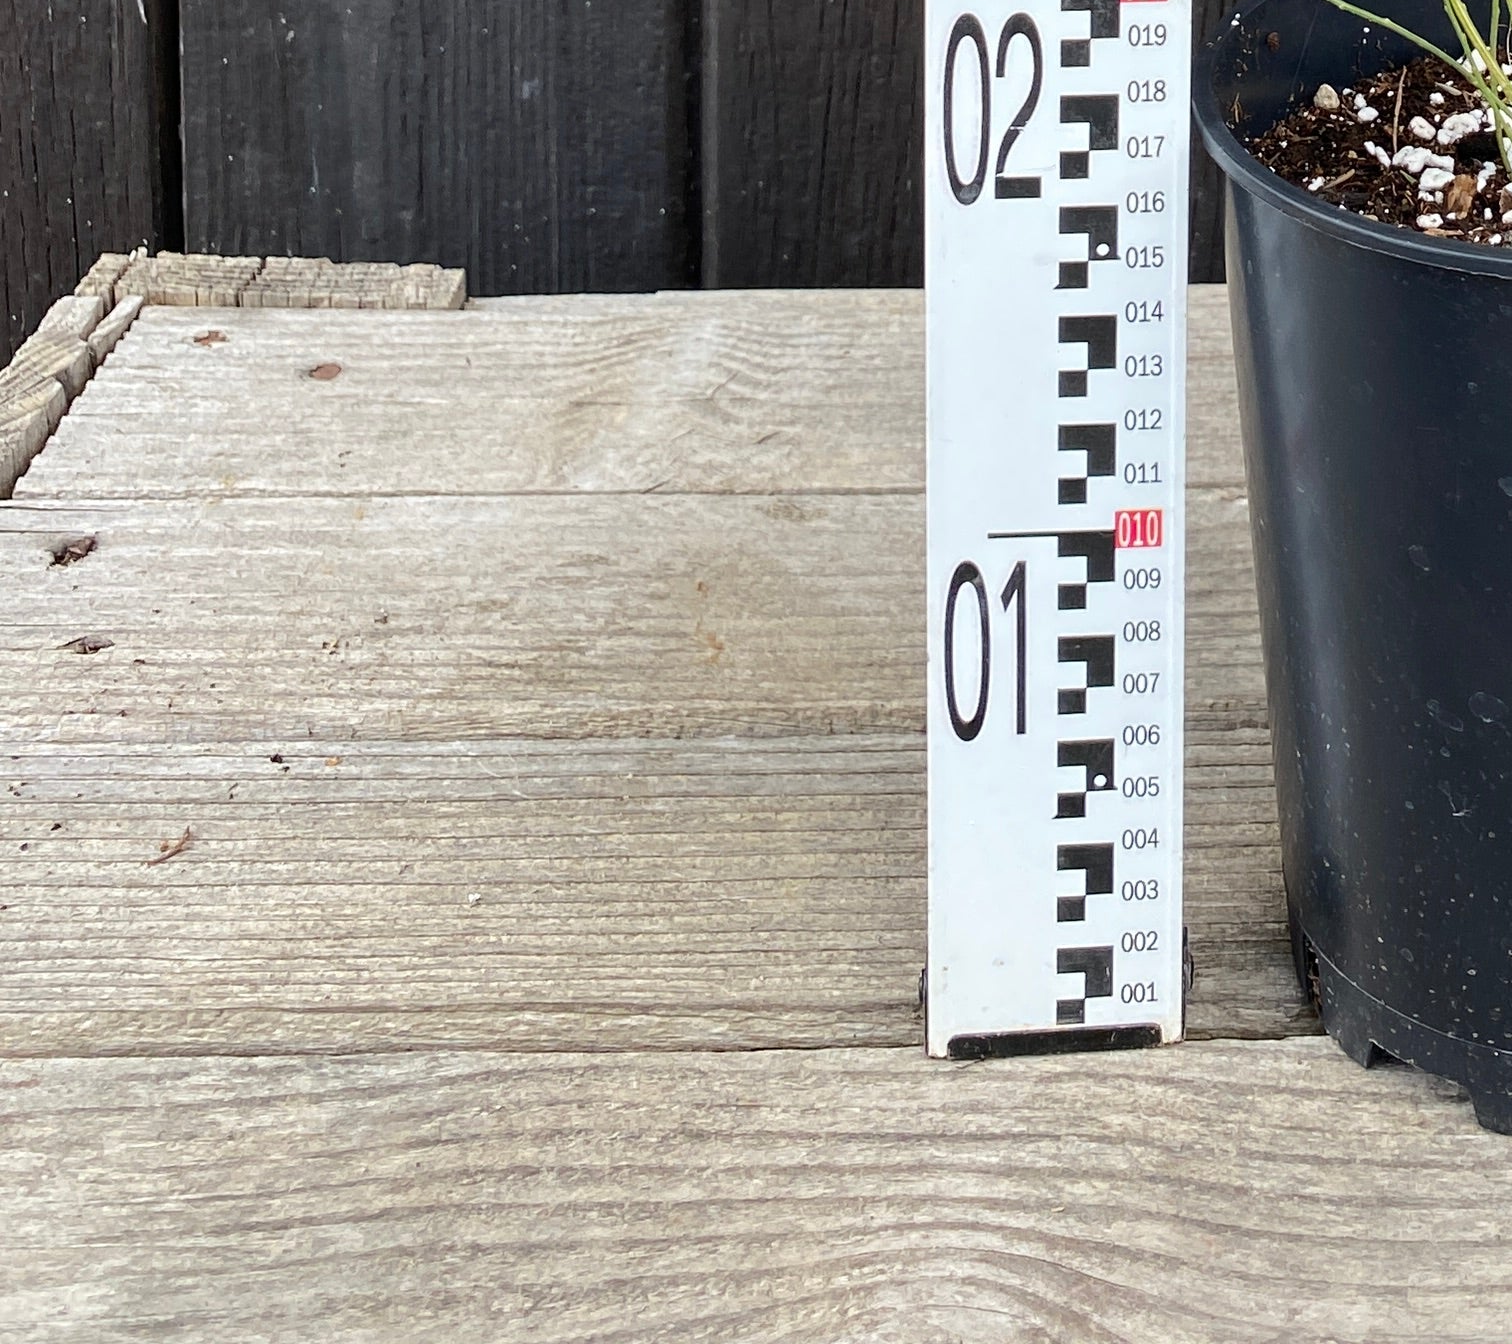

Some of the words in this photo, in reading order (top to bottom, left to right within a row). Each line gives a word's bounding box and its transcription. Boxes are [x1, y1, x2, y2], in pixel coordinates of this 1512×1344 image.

[1128, 24, 1166, 46] 019
[1128, 80, 1166, 103] 018
[943, 13, 1042, 205] 02
[1127, 136, 1164, 158] 017
[1127, 191, 1164, 213] 016
[1126, 246, 1164, 268] 015
[1125, 300, 1164, 323] 014
[1125, 355, 1162, 377] 013
[1125, 409, 1162, 431] 012
[1124, 462, 1162, 484] 011
[1118, 511, 1158, 547] 010
[1124, 568, 1161, 590] 009
[1123, 621, 1160, 642] 008
[944, 560, 1027, 741] 01
[1123, 673, 1160, 694] 007
[1123, 725, 1160, 746] 006
[1123, 776, 1159, 798] 005
[1122, 828, 1159, 849] 004
[1122, 880, 1158, 901] 003
[1121, 931, 1158, 952] 002
[1121, 982, 1158, 1003] 001
